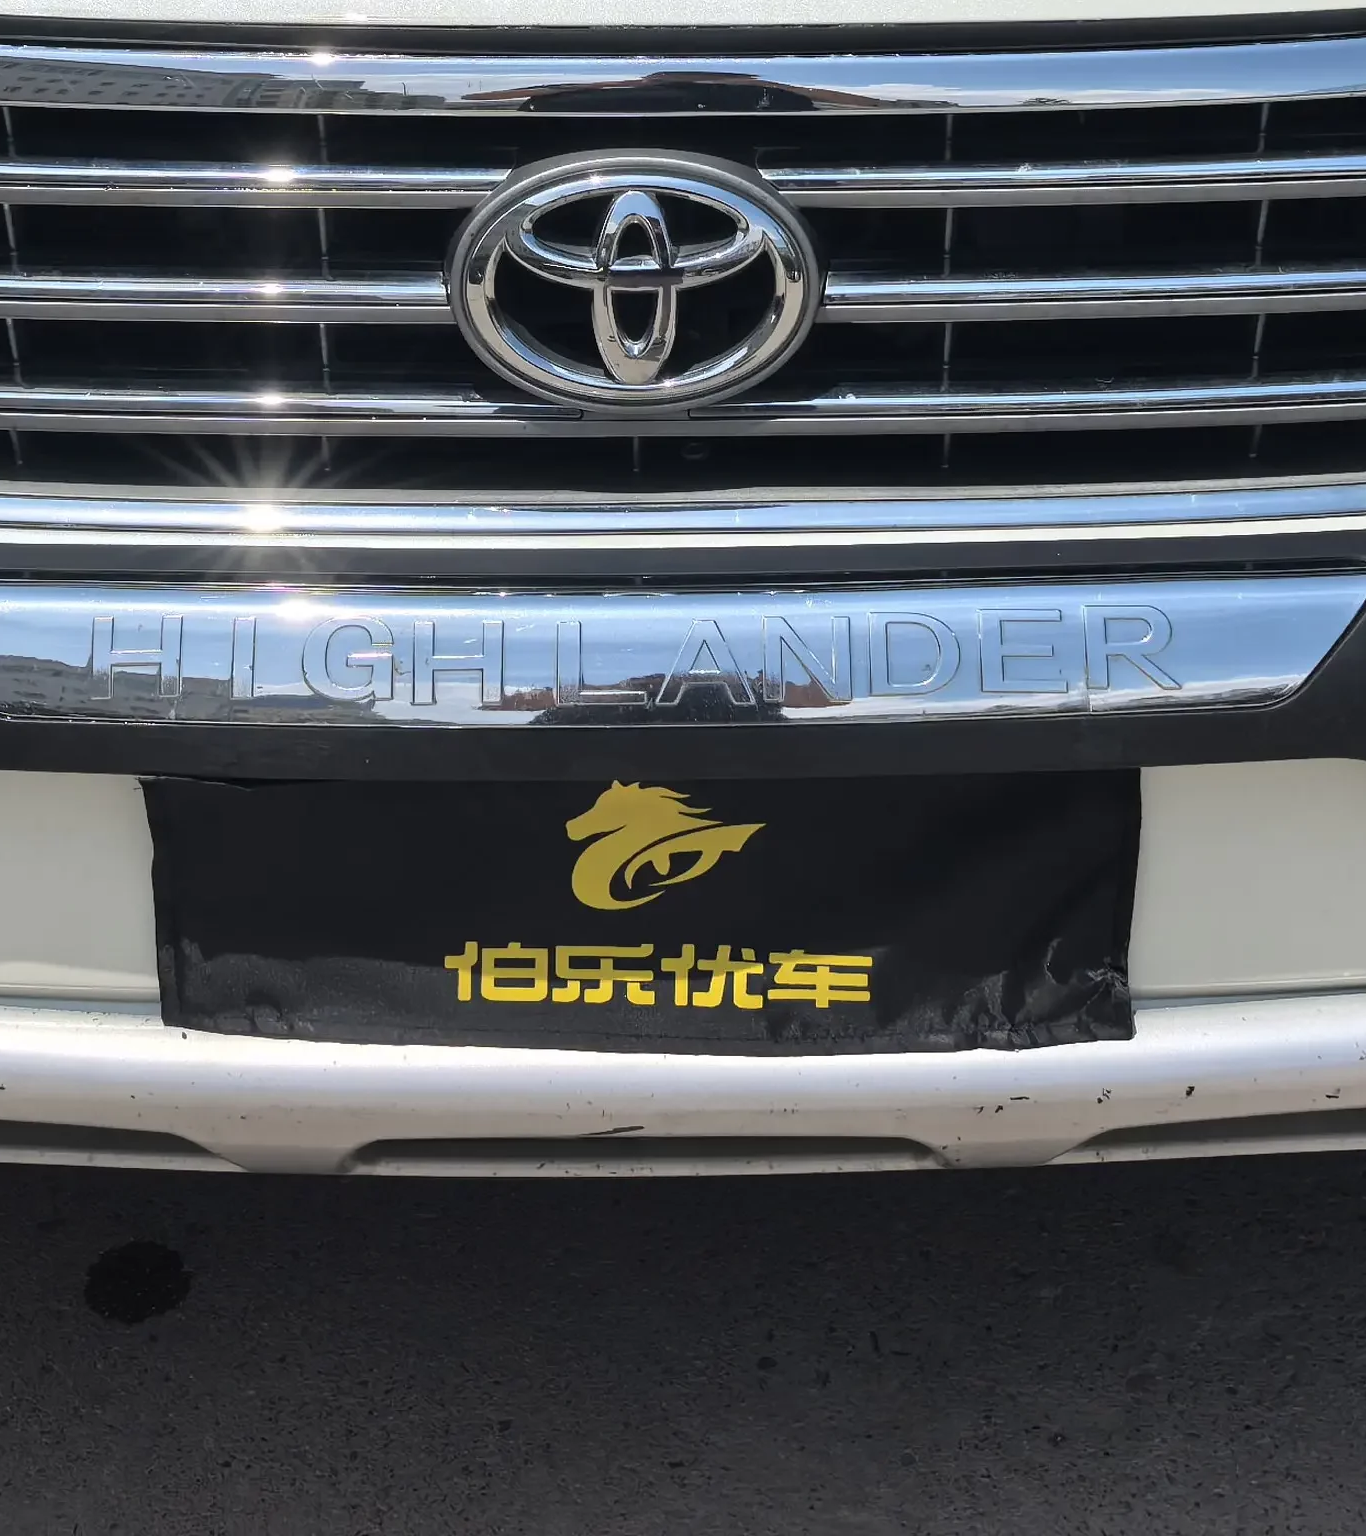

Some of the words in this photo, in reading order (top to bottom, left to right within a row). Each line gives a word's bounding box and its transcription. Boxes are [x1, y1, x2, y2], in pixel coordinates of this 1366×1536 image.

[90, 604, 1183, 706] HIGHLANDER
[444, 941, 873, 1009] 伯乐优车
